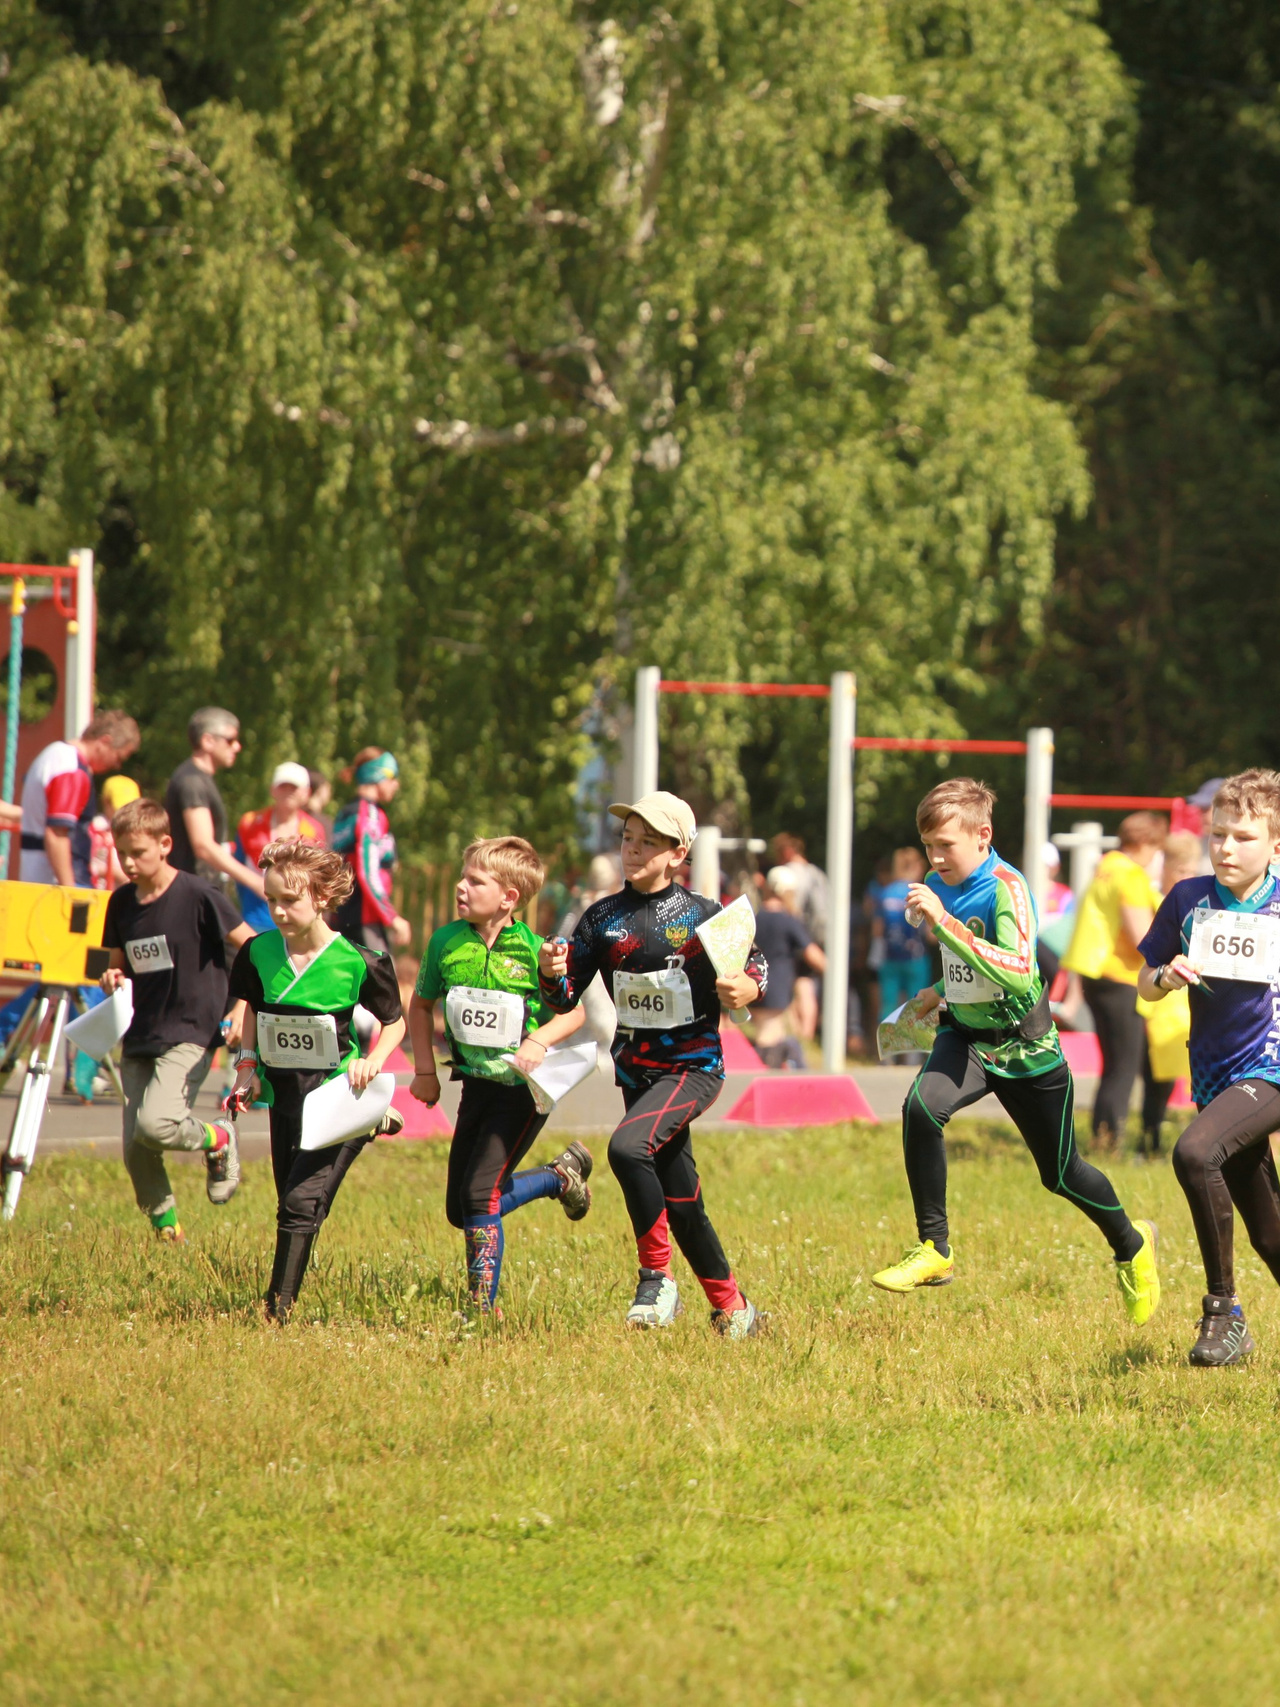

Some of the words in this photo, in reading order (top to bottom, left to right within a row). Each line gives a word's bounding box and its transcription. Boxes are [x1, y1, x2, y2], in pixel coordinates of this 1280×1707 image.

[132, 942, 160, 960] 659
[1212, 934, 1255, 958] 656
[949, 963, 974, 983] 653
[628, 994, 665, 1012] 646
[461, 1008, 498, 1029] 652
[276, 1031, 314, 1050] 639
